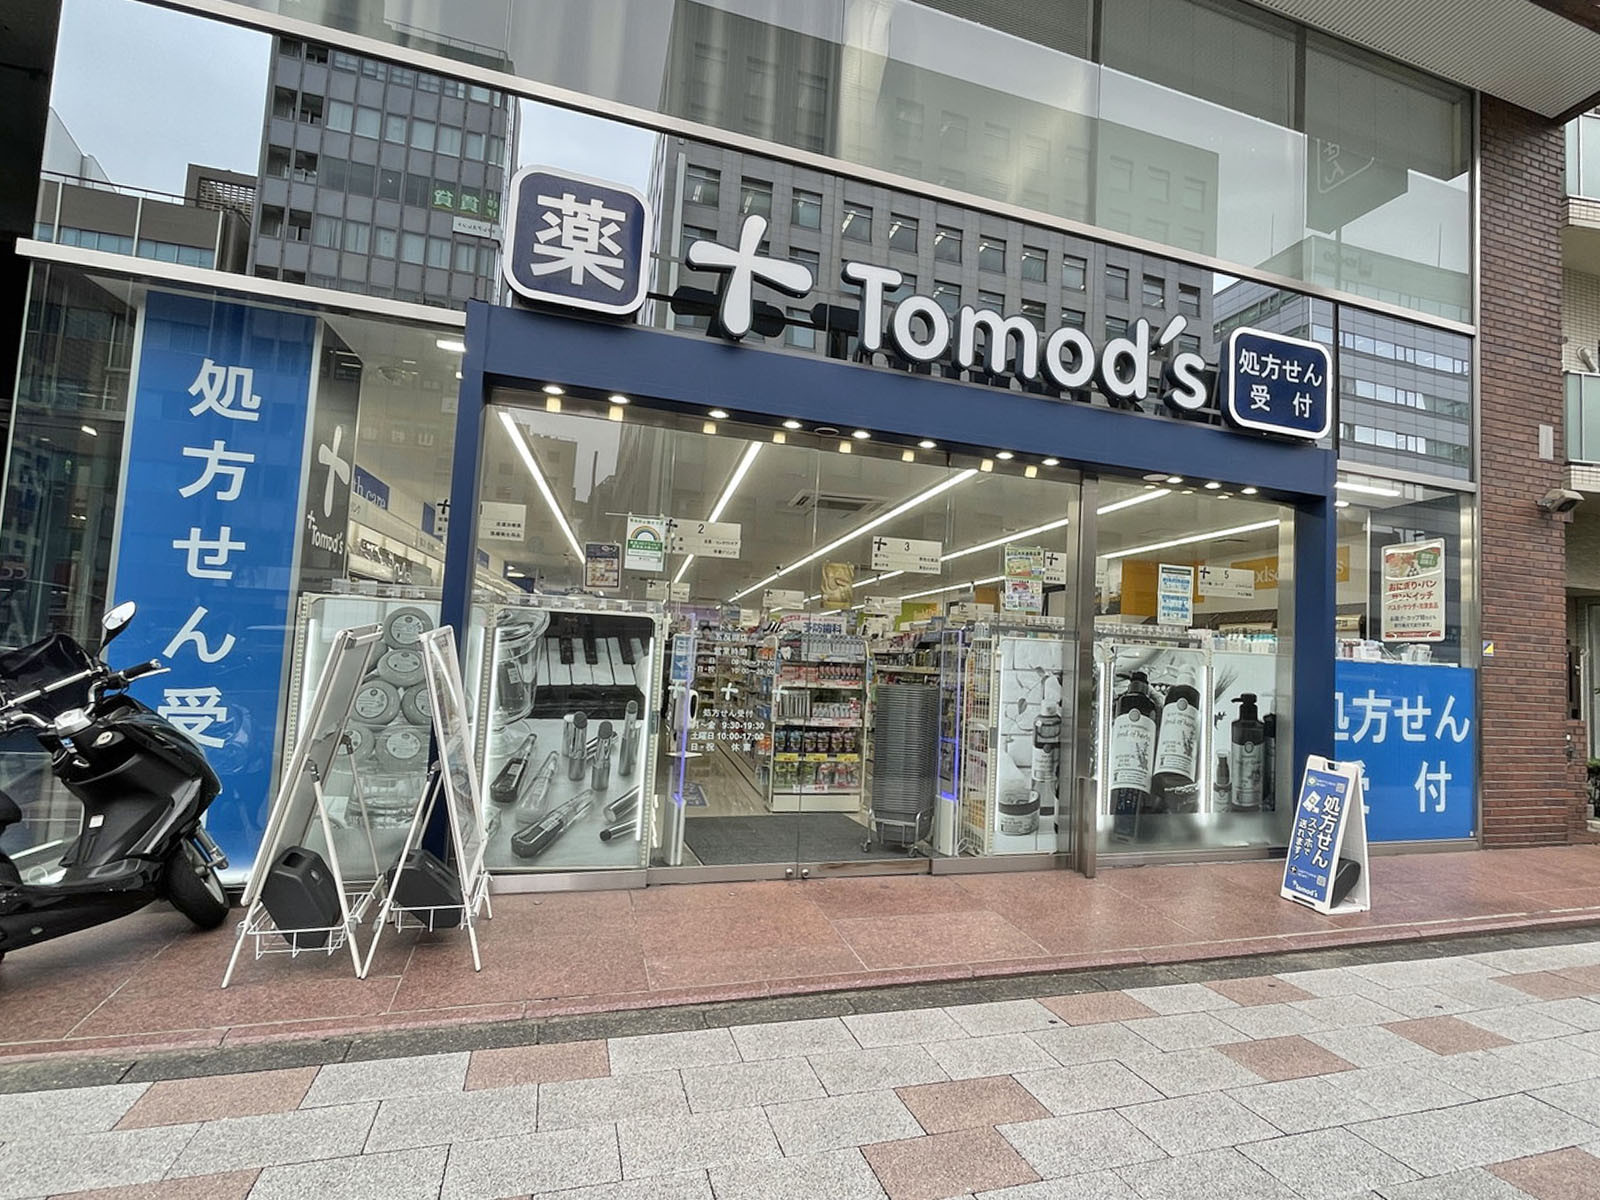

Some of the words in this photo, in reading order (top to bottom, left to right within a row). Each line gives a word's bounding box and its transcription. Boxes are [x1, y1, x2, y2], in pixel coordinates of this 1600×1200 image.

[529, 192, 627, 292] 薬
[842, 262, 1208, 411] Tomod's
[1238, 346, 1323, 386] 処方せん
[1250, 385, 1313, 420] 受付
[311, 524, 344, 555] Tomod's
[698, 523, 705, 534] 2
[904, 541, 910, 552] 3
[158, 357, 260, 829] 処方せん受
[1224, 570, 1230, 579] 5
[703, 708, 753, 718] 処方せん受付
[1303, 817, 1318, 857] スマホで
[1311, 794, 1341, 869] 処方せん
